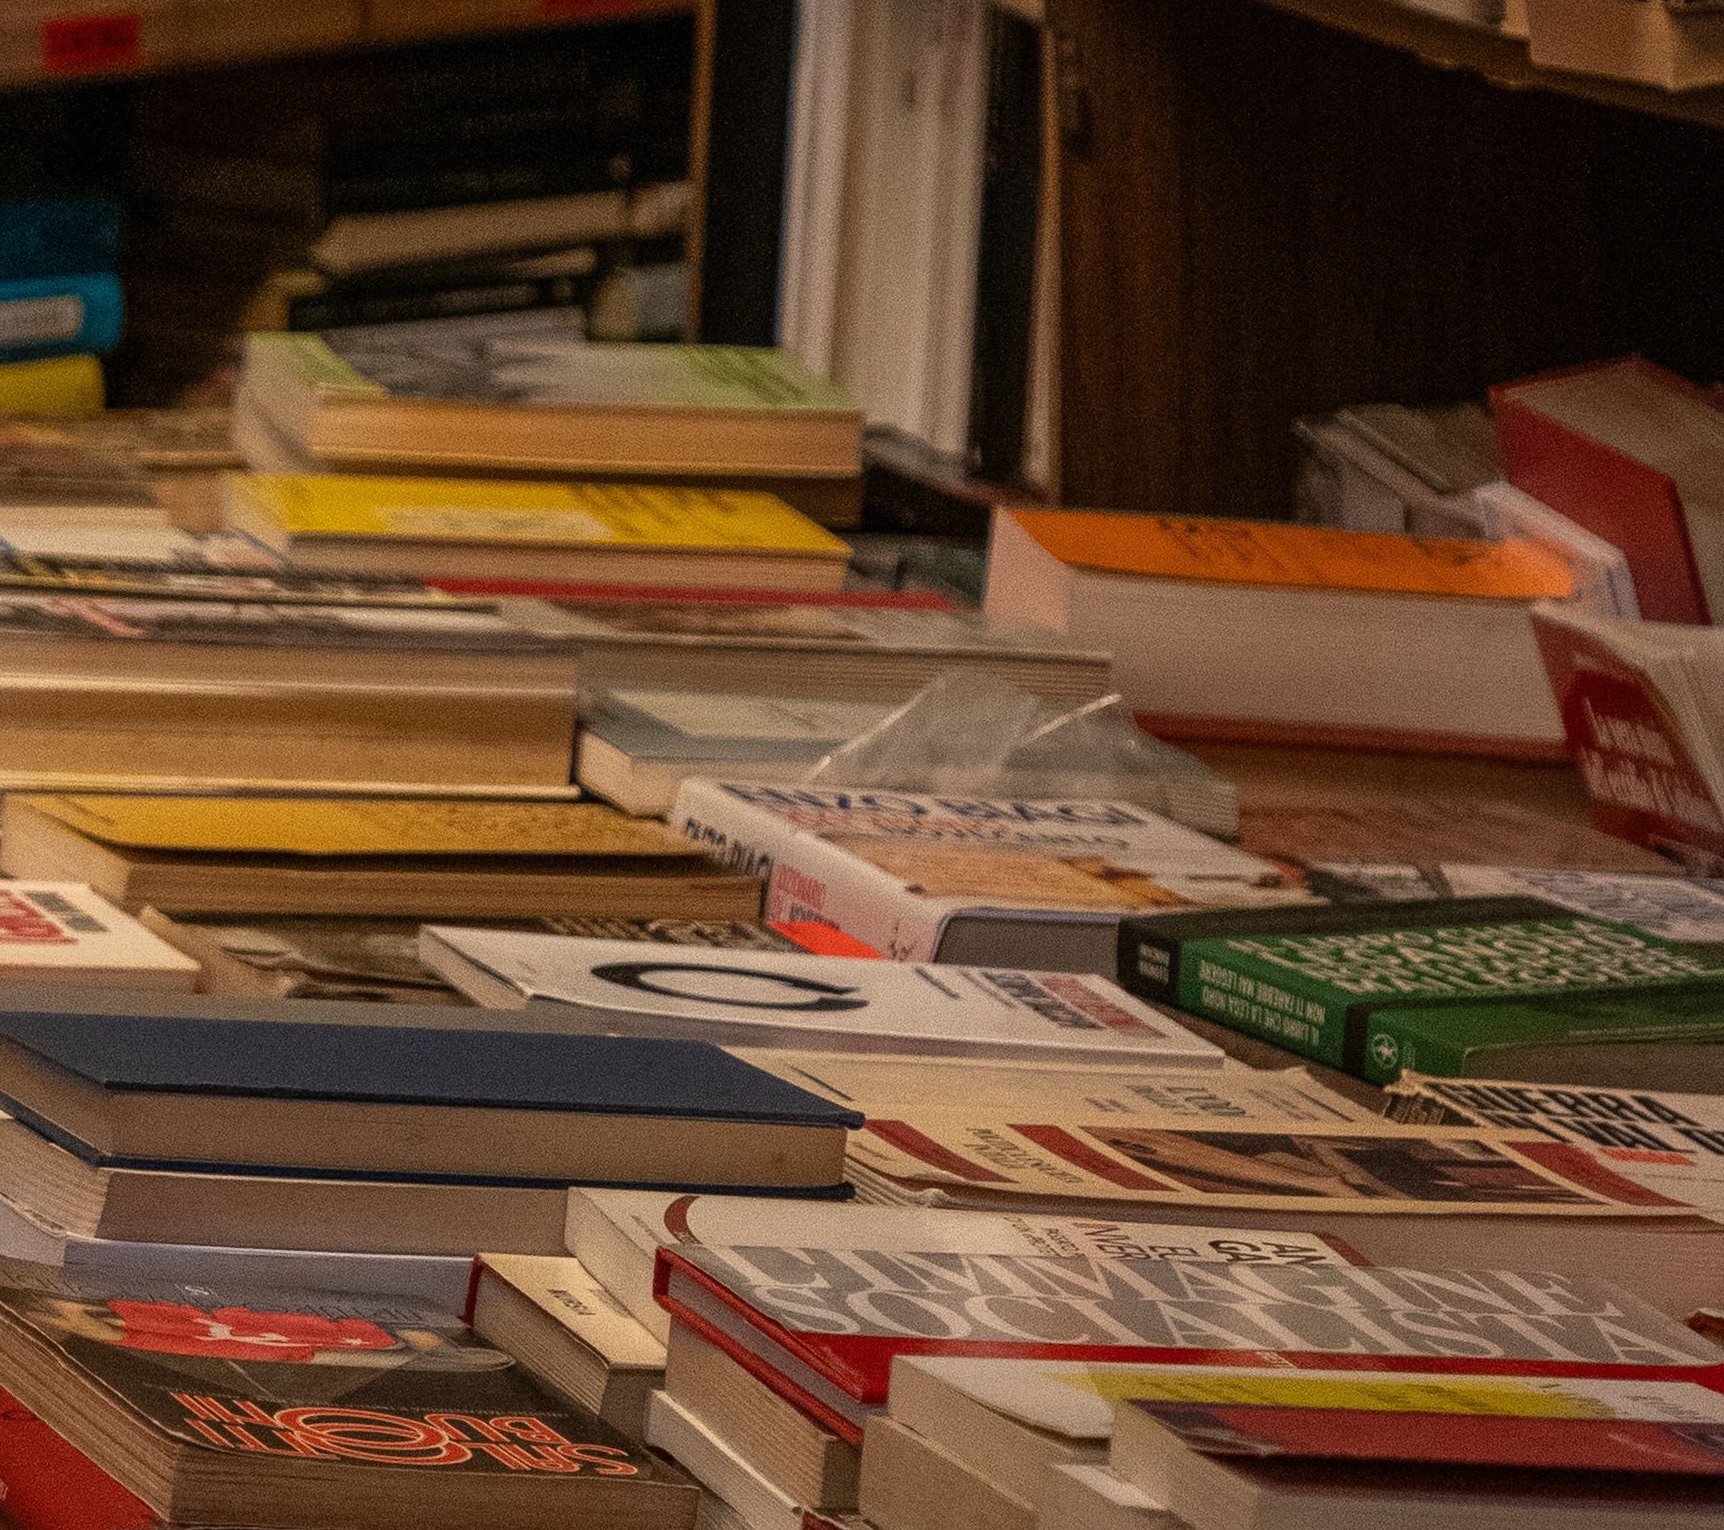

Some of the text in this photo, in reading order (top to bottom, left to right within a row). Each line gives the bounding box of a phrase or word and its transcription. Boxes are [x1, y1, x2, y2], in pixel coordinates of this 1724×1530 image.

[719, 783, 1147, 825] ENZO BIAGI
[1425, 1081, 1704, 1128] GUERRA
[751, 1284, 1707, 1368] SOCIALISTA
